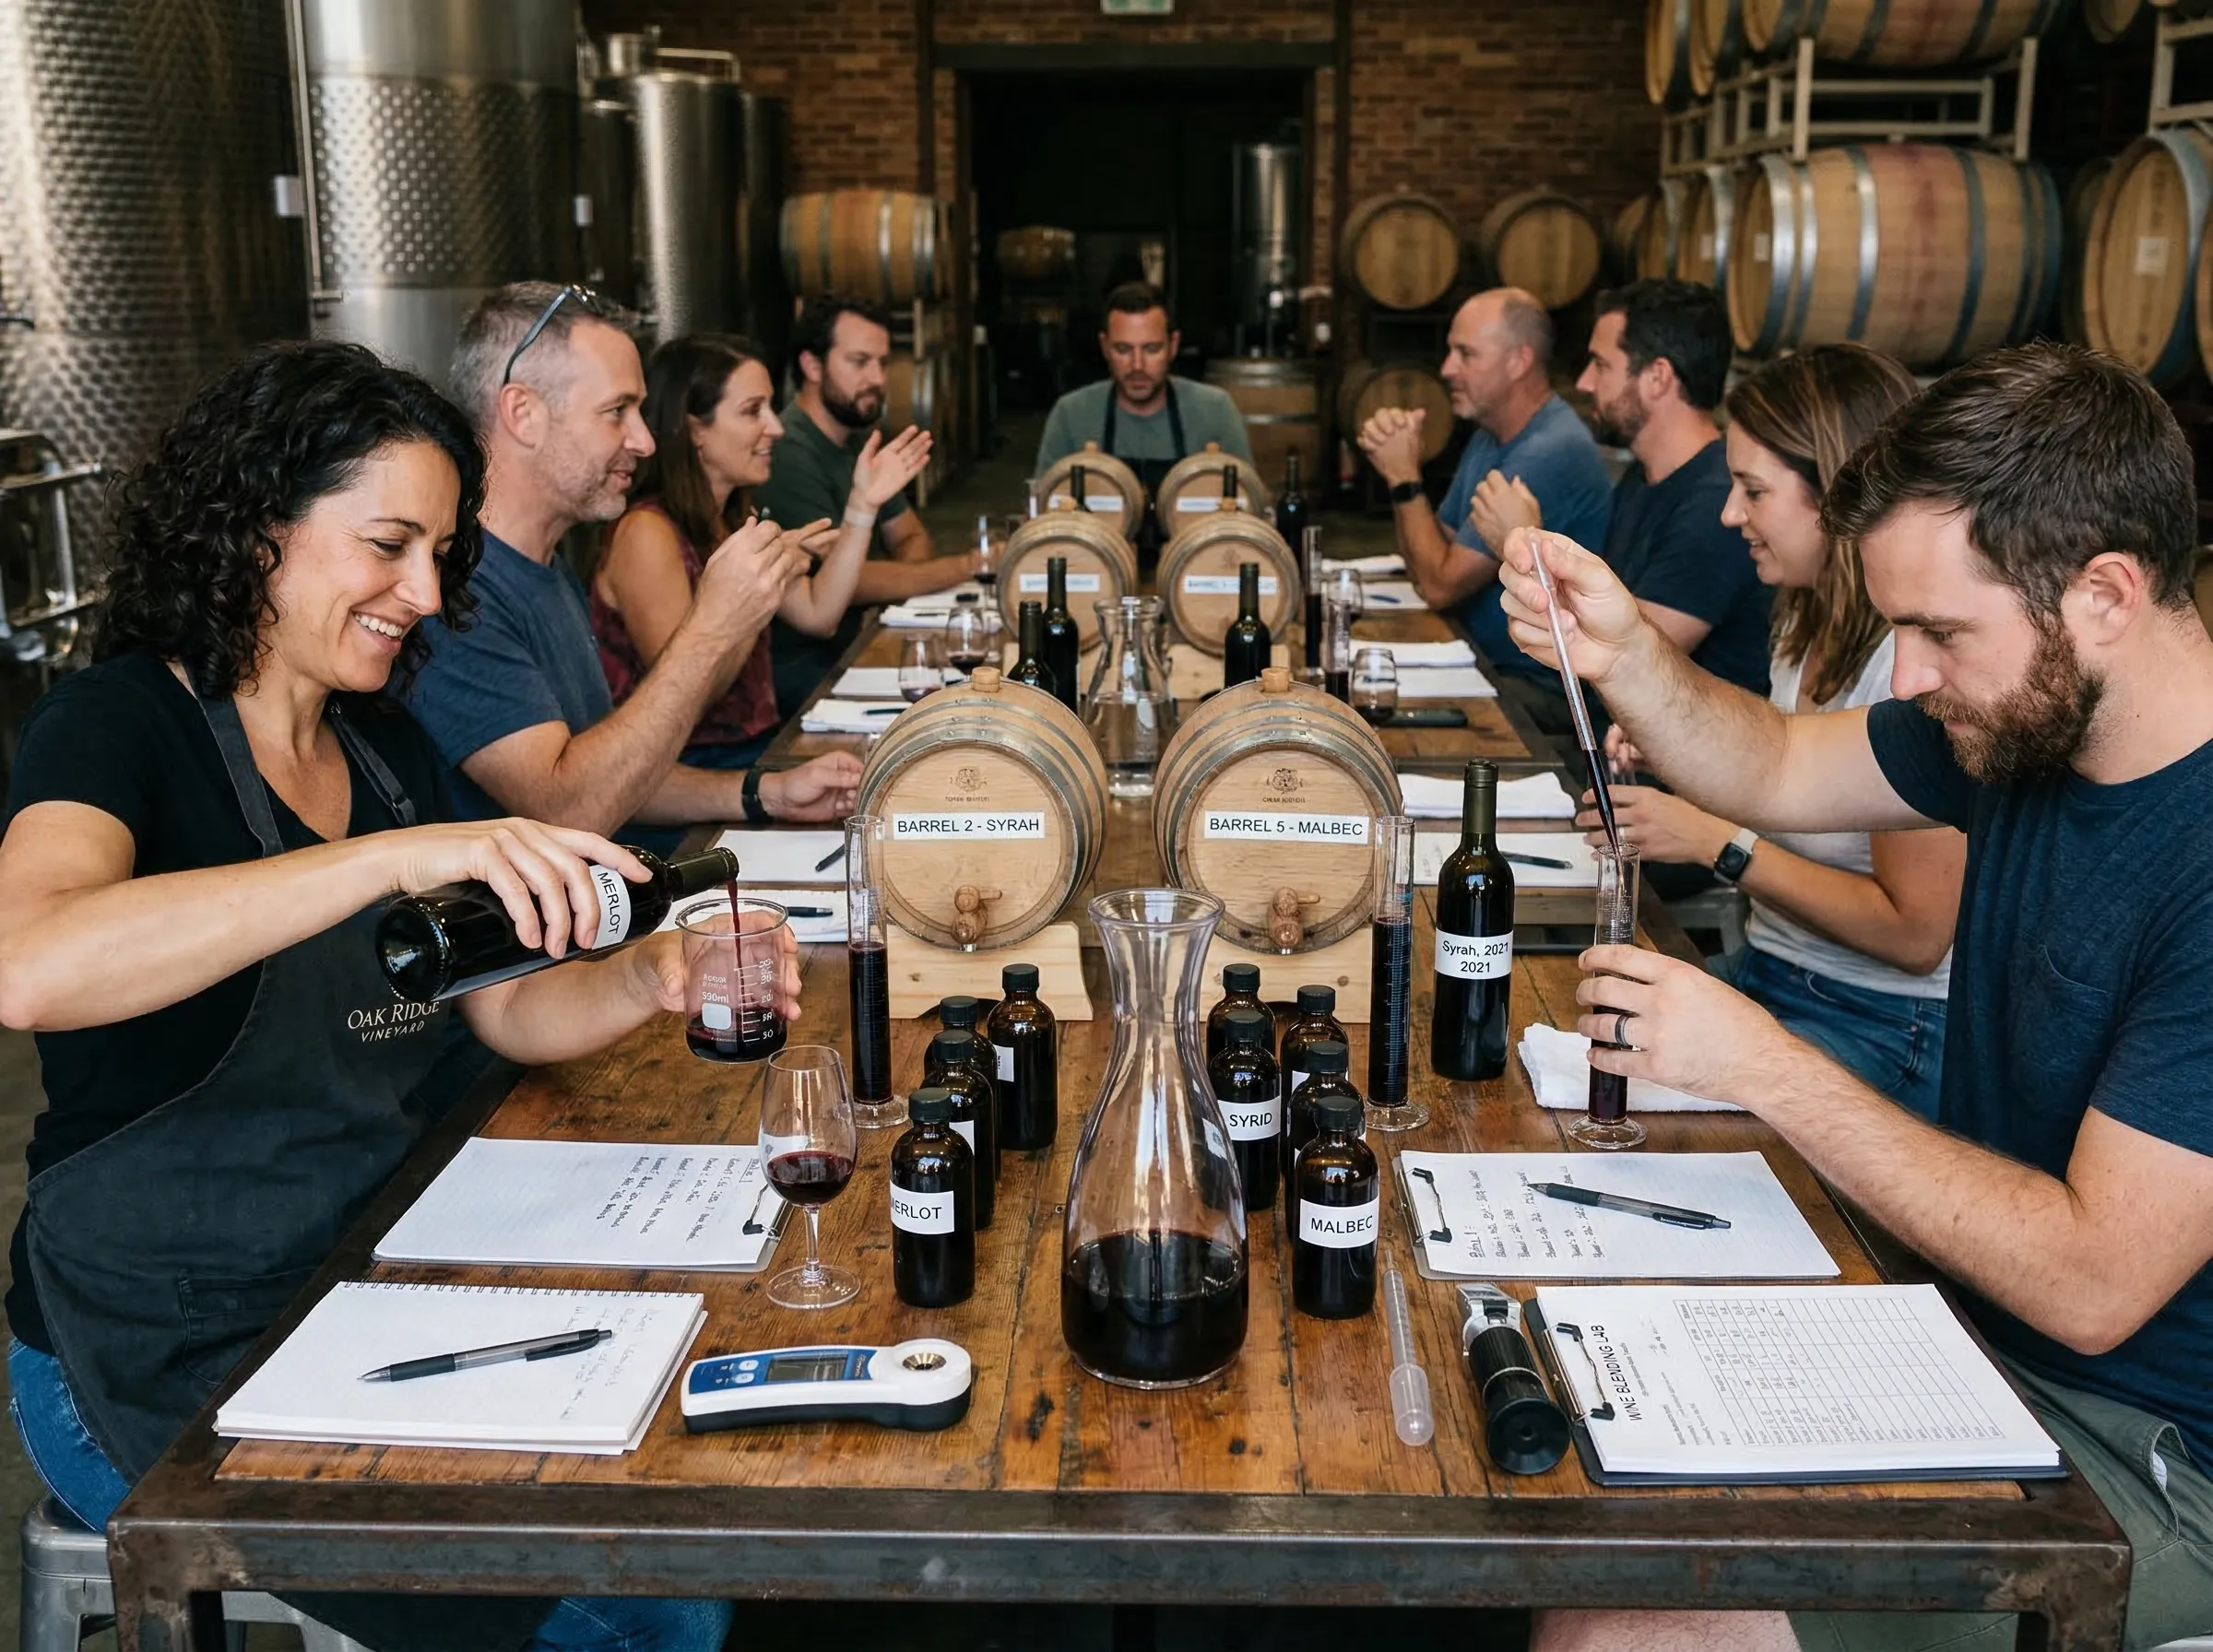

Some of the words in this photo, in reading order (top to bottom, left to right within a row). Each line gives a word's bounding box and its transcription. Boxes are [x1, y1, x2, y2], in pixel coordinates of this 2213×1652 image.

[897, 820, 960, 832] BARREL
[964, 820, 973, 832] 2
[986, 819, 1039, 832] SYRAH
[1210, 818, 1272, 832] BARREL
[1276, 820, 1284, 832] 5
[1298, 821, 1363, 835] MALBEC
[597, 872, 621, 934] MERLOT
[1442, 940, 1480, 957] Syrah,
[1484, 942, 1509, 956] 2021
[1461, 961, 1490, 973] 2021
[348, 1008, 387, 1030] OAK
[390, 1001, 440, 1023] RIDGE
[361, 1020, 425, 1043] VINEYARD
[1229, 1112, 1272, 1127] SYRID
[1310, 1214, 1373, 1233] MALBEC
[1591, 1325, 1608, 1343] LAB
[1599, 1345, 1631, 1394] BLENDING
[1619, 1396, 1643, 1422] WINE
